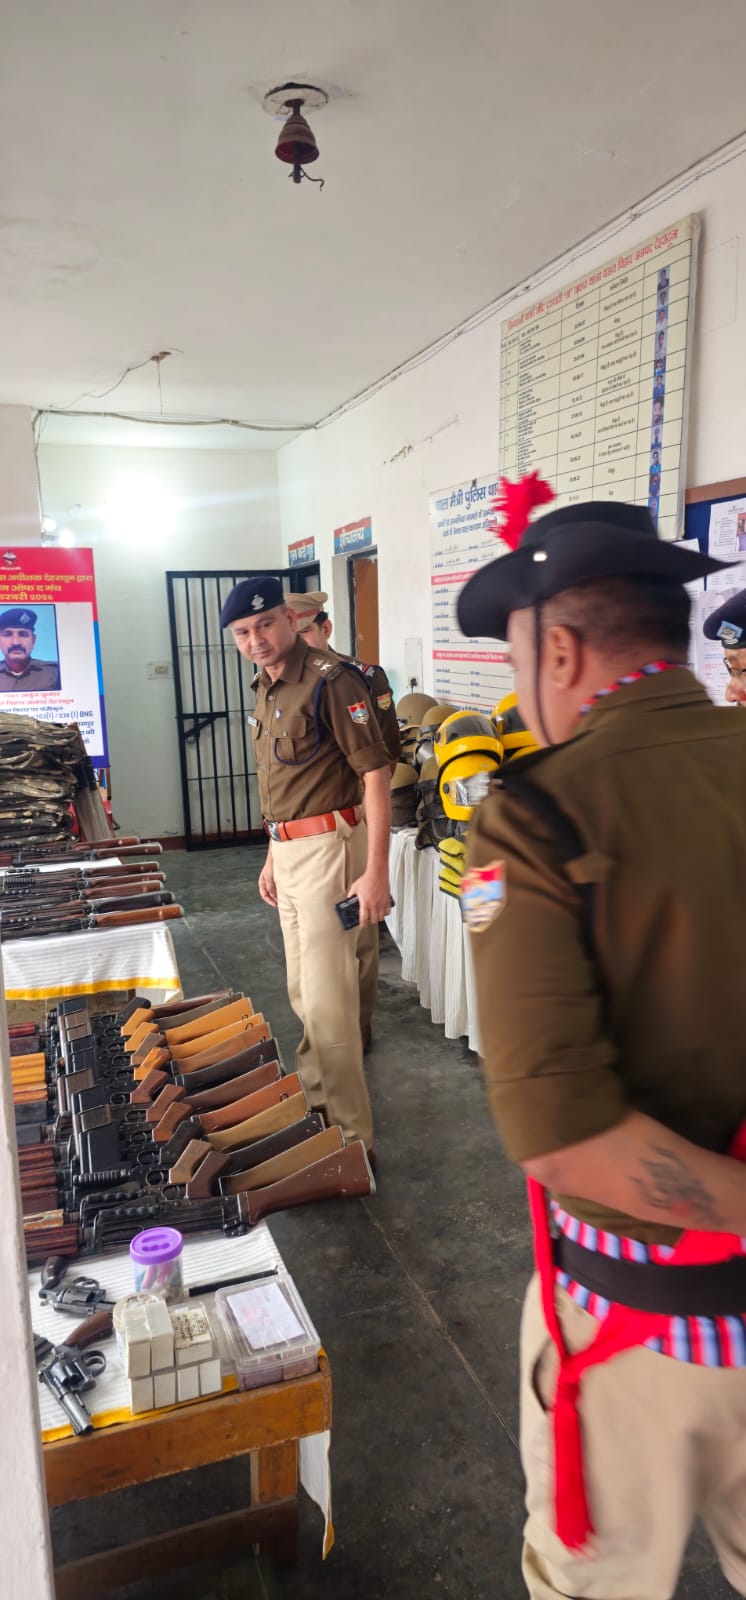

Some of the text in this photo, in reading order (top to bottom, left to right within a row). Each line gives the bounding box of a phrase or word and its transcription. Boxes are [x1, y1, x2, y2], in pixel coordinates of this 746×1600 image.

[449, 488, 463, 507] मैत्री
[465, 484, 486, 510] पुलिस
[79, 710, 94, 718] BNS
